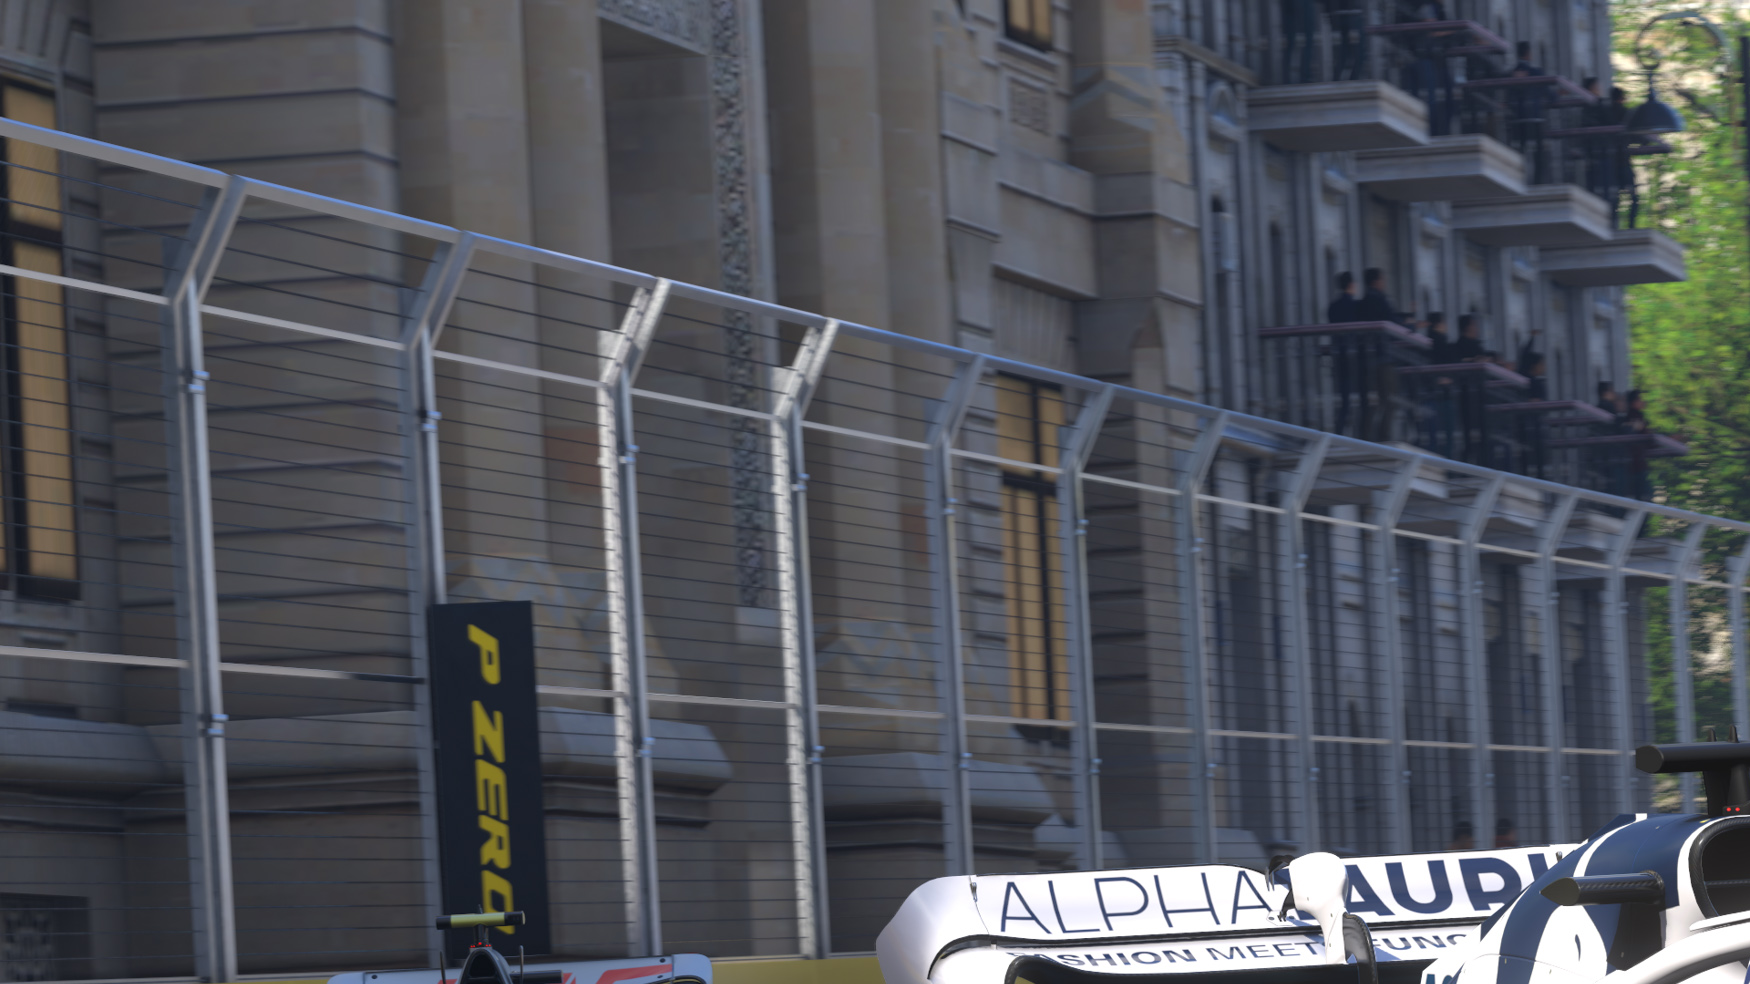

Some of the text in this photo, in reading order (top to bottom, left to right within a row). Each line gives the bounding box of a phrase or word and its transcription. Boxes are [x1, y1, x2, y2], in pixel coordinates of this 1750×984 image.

[467, 624, 516, 935] P ZERO
[1000, 870, 1274, 935] ALPHA
[1205, 942, 1320, 961] MEET
